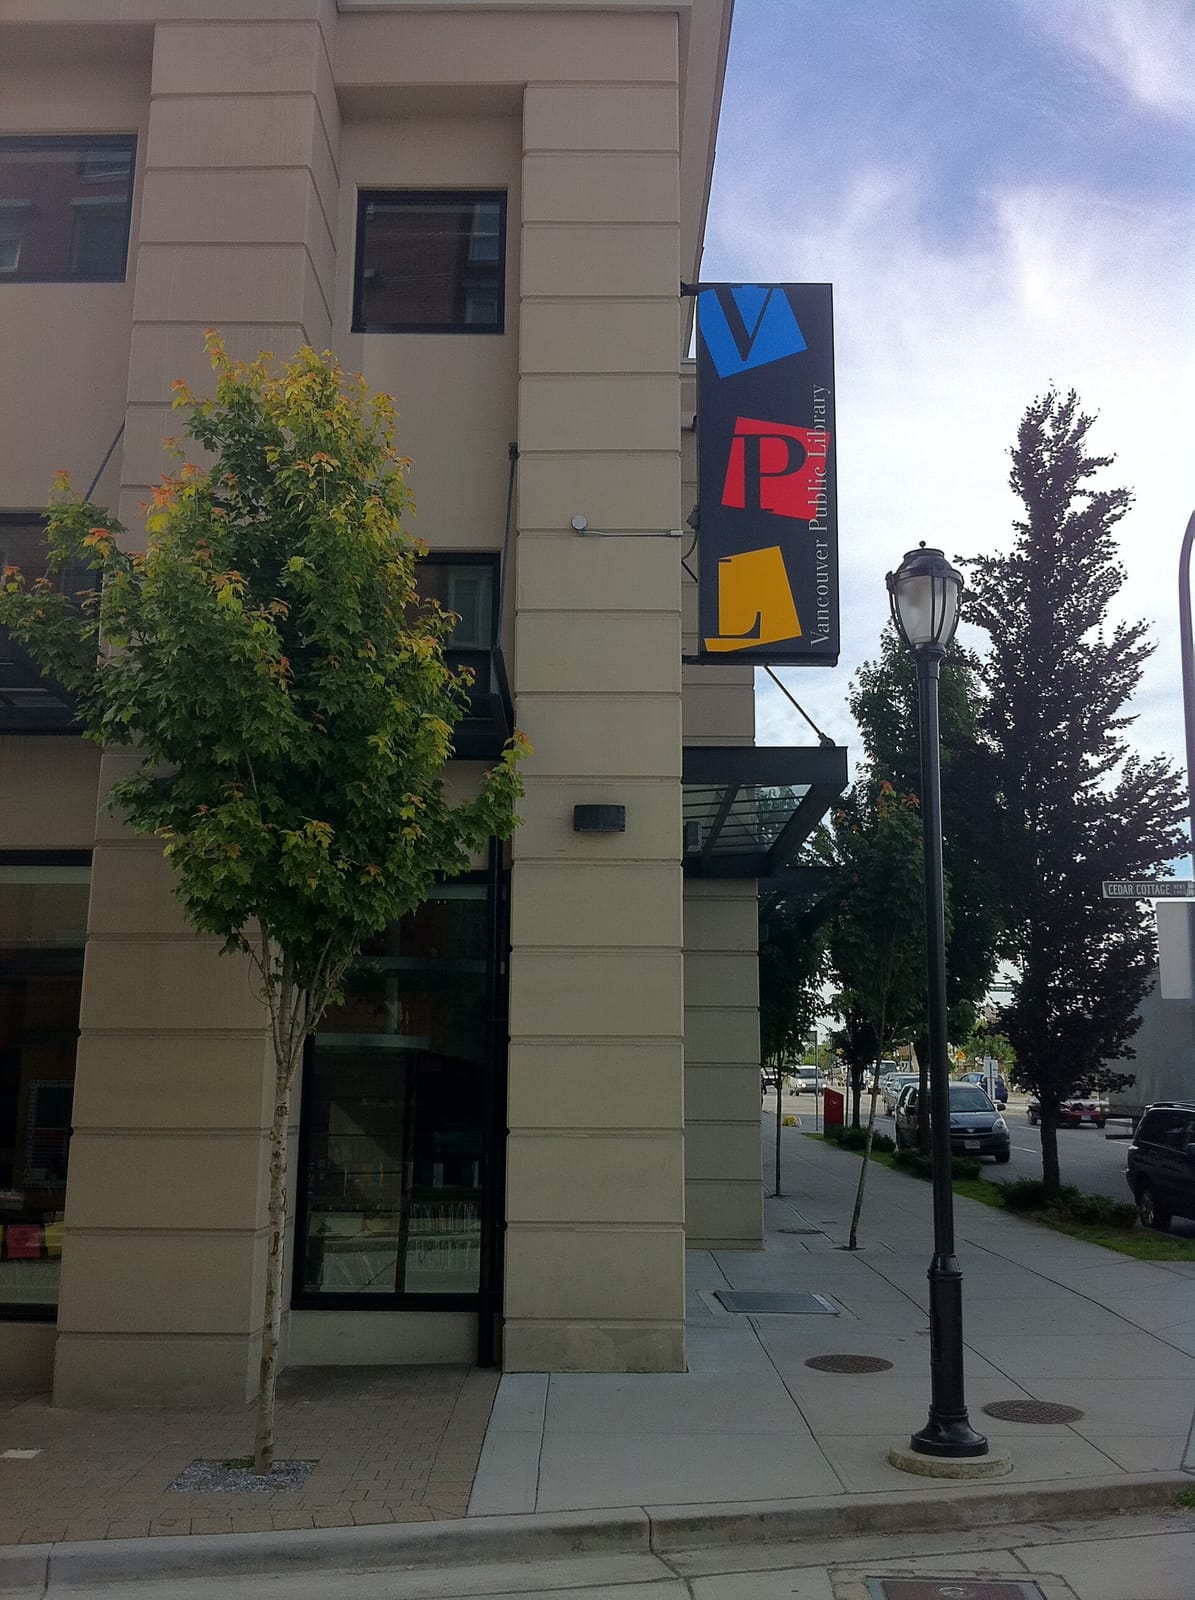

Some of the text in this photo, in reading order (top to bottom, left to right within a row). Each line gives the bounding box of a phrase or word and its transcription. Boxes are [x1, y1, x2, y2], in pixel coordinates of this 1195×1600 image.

[806, 383, 831, 646] Vancouver Public Library
[1108, 884, 1134, 895] CEDAR
[1136, 884, 1171, 895] COTTAGE
